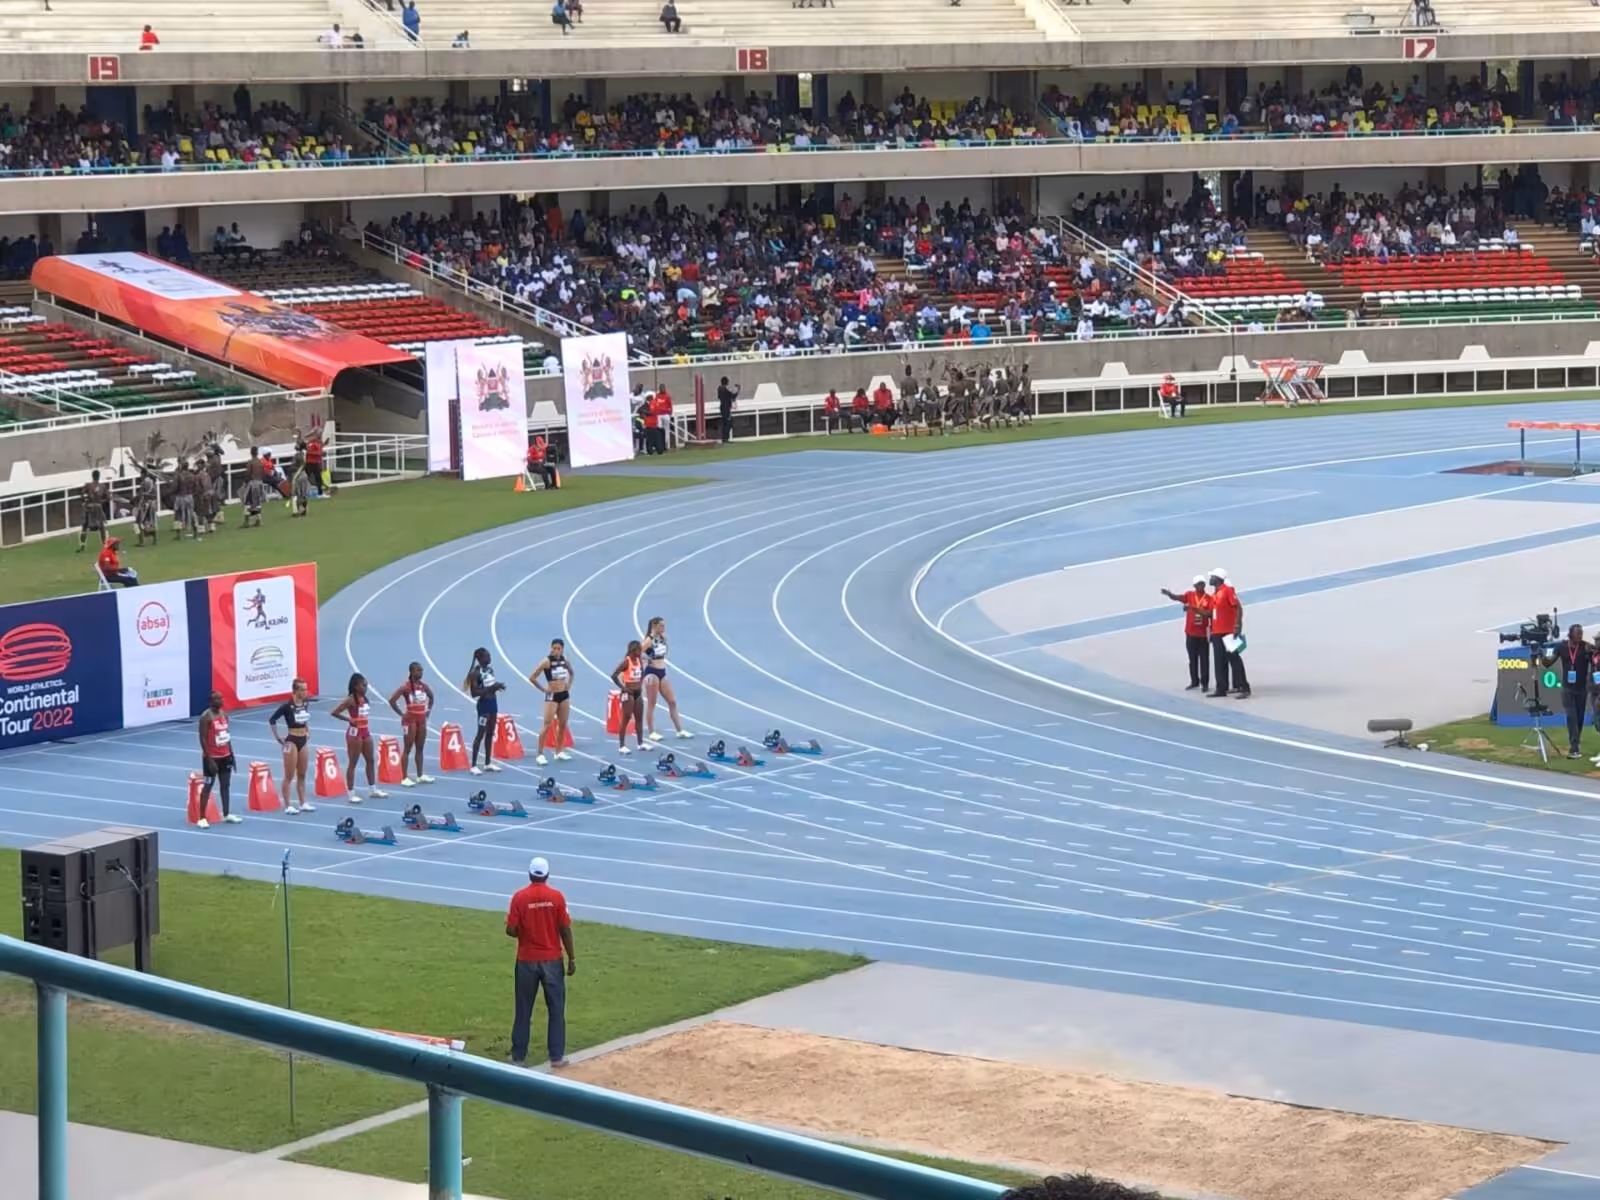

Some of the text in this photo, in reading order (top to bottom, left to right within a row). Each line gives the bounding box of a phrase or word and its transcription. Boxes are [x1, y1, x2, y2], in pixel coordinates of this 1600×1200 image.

[1405, 38, 1435, 59] 17
[90, 56, 118, 80] 19
[738, 49, 767, 70] 18
[141, 616, 166, 630] absa
[1497, 659, 1528, 669] 5000m
[7, 683, 31, 694] WORLD
[147, 697, 172, 708] KENYA
[0, 707, 73, 736] Tour 2022
[505, 722, 515, 741] 3
[448, 733, 460, 752] 4
[388, 744, 399, 766] 5
[325, 758, 336, 779] 6
[257, 770, 268, 792] 7
